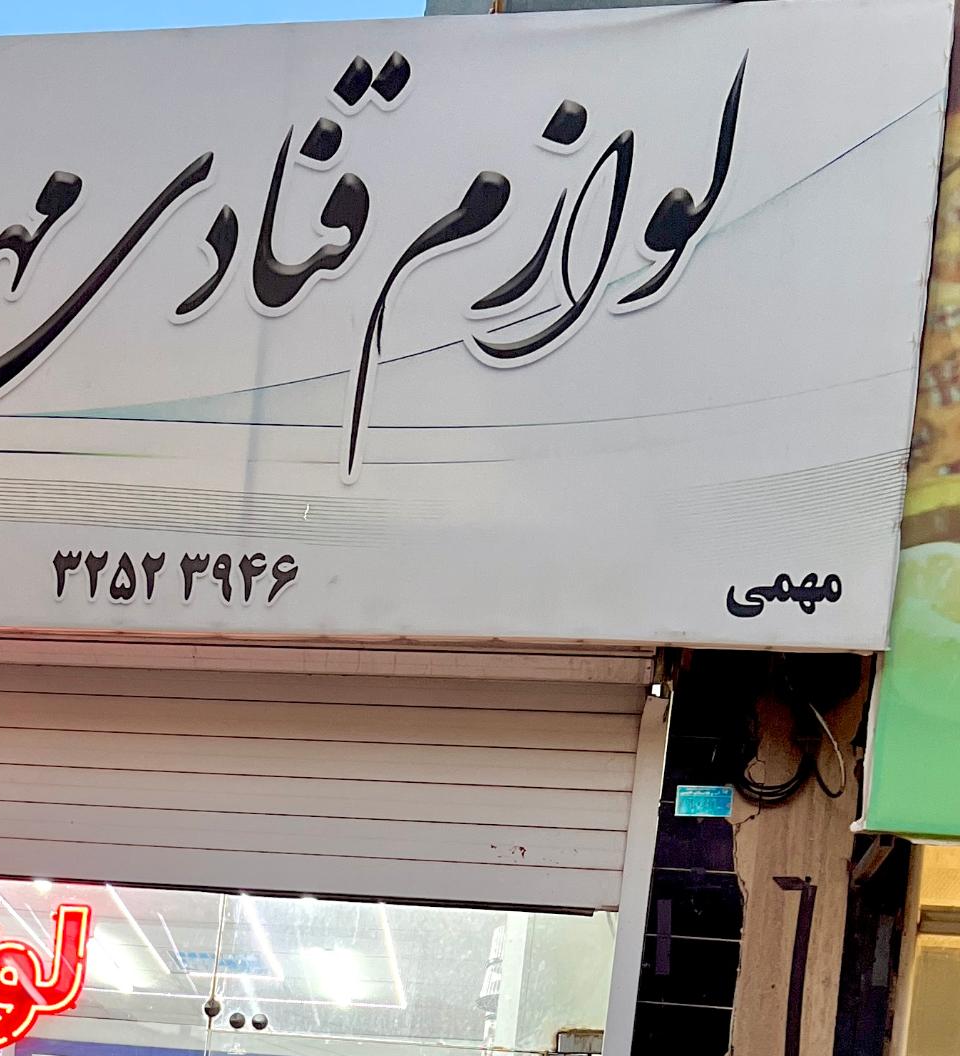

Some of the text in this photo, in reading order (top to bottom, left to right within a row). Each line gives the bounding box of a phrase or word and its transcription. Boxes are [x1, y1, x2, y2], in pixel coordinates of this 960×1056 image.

[345, 47, 751, 477] لوازم
[52, 550, 299, 603] ۳۲۵۲ ۳۹۴۶
[726, 572, 842, 618] مهمی
